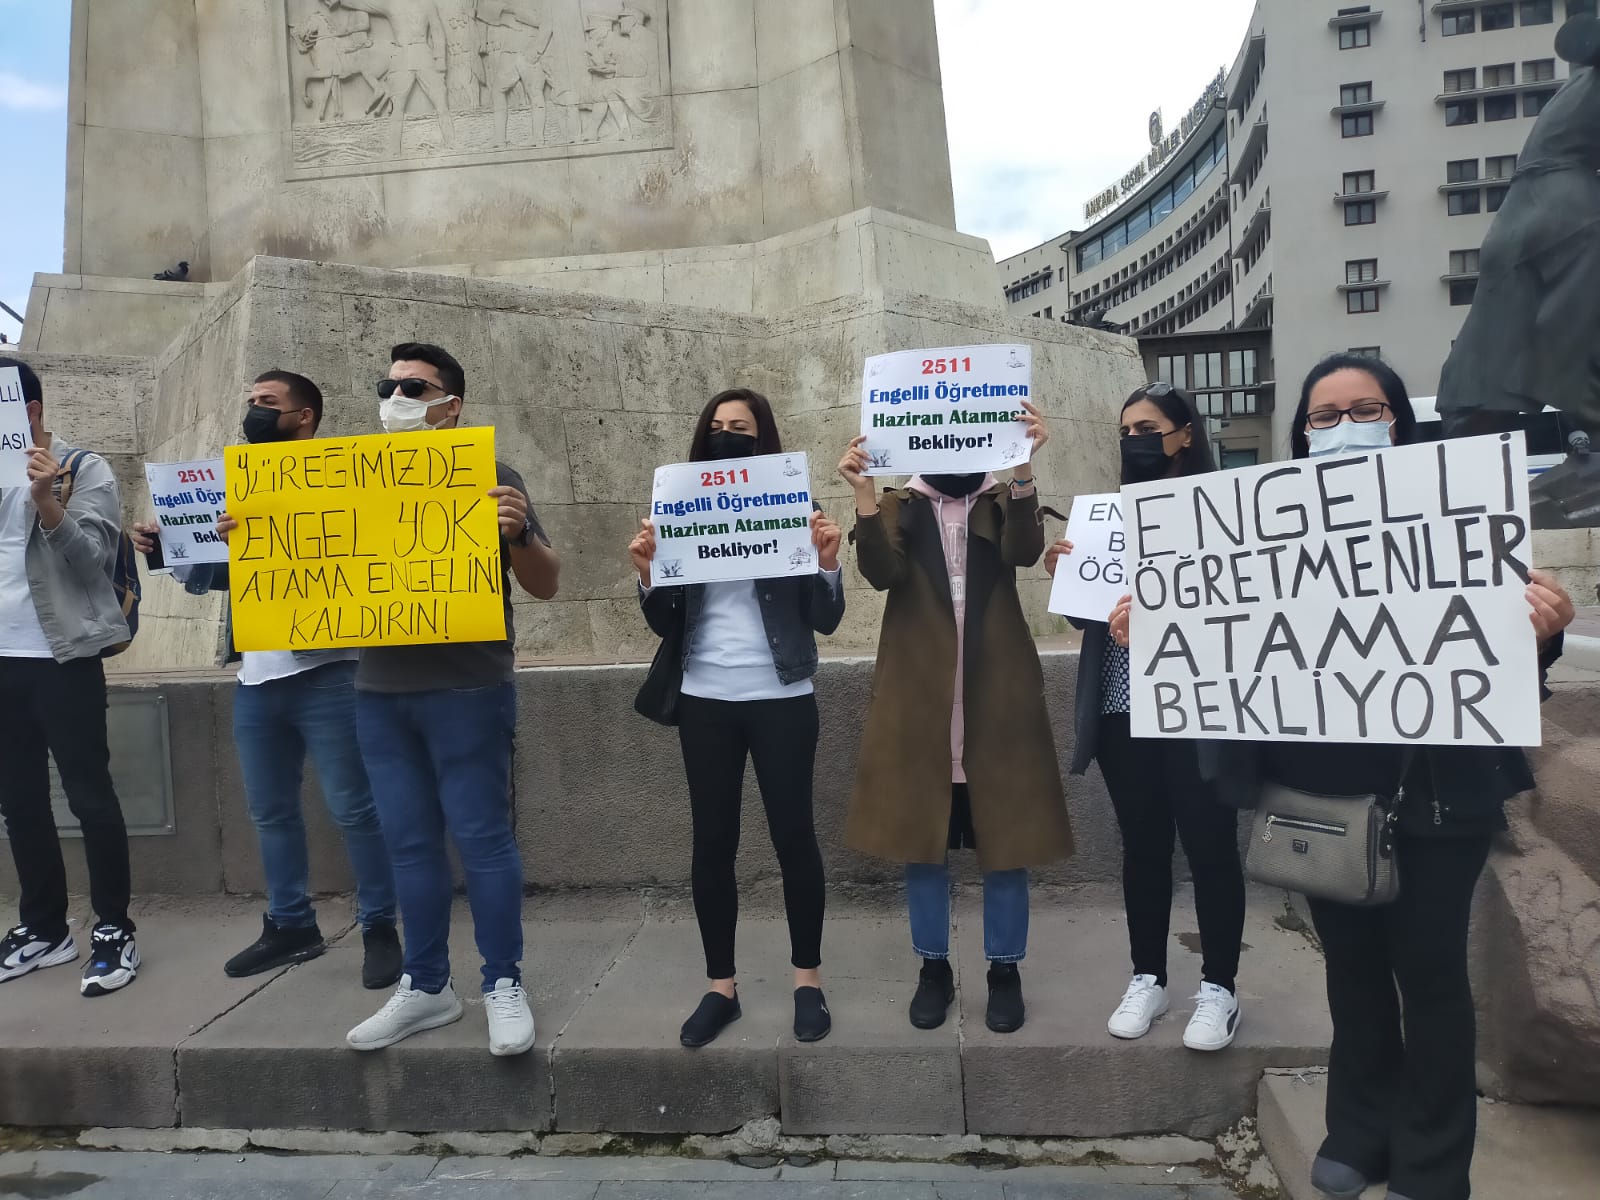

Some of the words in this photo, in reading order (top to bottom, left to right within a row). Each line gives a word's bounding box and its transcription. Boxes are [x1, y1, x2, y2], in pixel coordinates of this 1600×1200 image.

[1085, 185, 1119, 219] ANKARA
[921, 357, 972, 375] 2511
[869, 385, 929, 405] Engelli
[935, 381, 1028, 403] Öğretmen
[872, 411, 943, 428] Haziran
[0, 433, 27, 450] ASI
[908, 433, 993, 452] Bekliyor!
[177, 468, 215, 483] 2511
[701, 468, 749, 487] 2511
[152, 491, 194, 508] Engelli
[653, 497, 713, 517] Engelli
[717, 491, 810, 513] Öğretmen
[1135, 432, 1515, 560] ENGELLİ
[160, 512, 213, 526] Haziran
[659, 522, 730, 539] Haziran
[734, 516, 808, 533] Ataması
[238, 508, 378, 561] ENGEL
[697, 539, 779, 559] Bekliyor!
[1078, 556, 1129, 586] ÖĞ
[1135, 514, 1532, 611] ÖĞRETMENLER
[239, 564, 354, 603] ATAMA
[368, 549, 500, 595] ENGELİNİ
[289, 599, 450, 645] KALDIRIN!
[1143, 594, 1500, 678] ATAMA
[1153, 669, 1504, 744] BEKLİYOR
